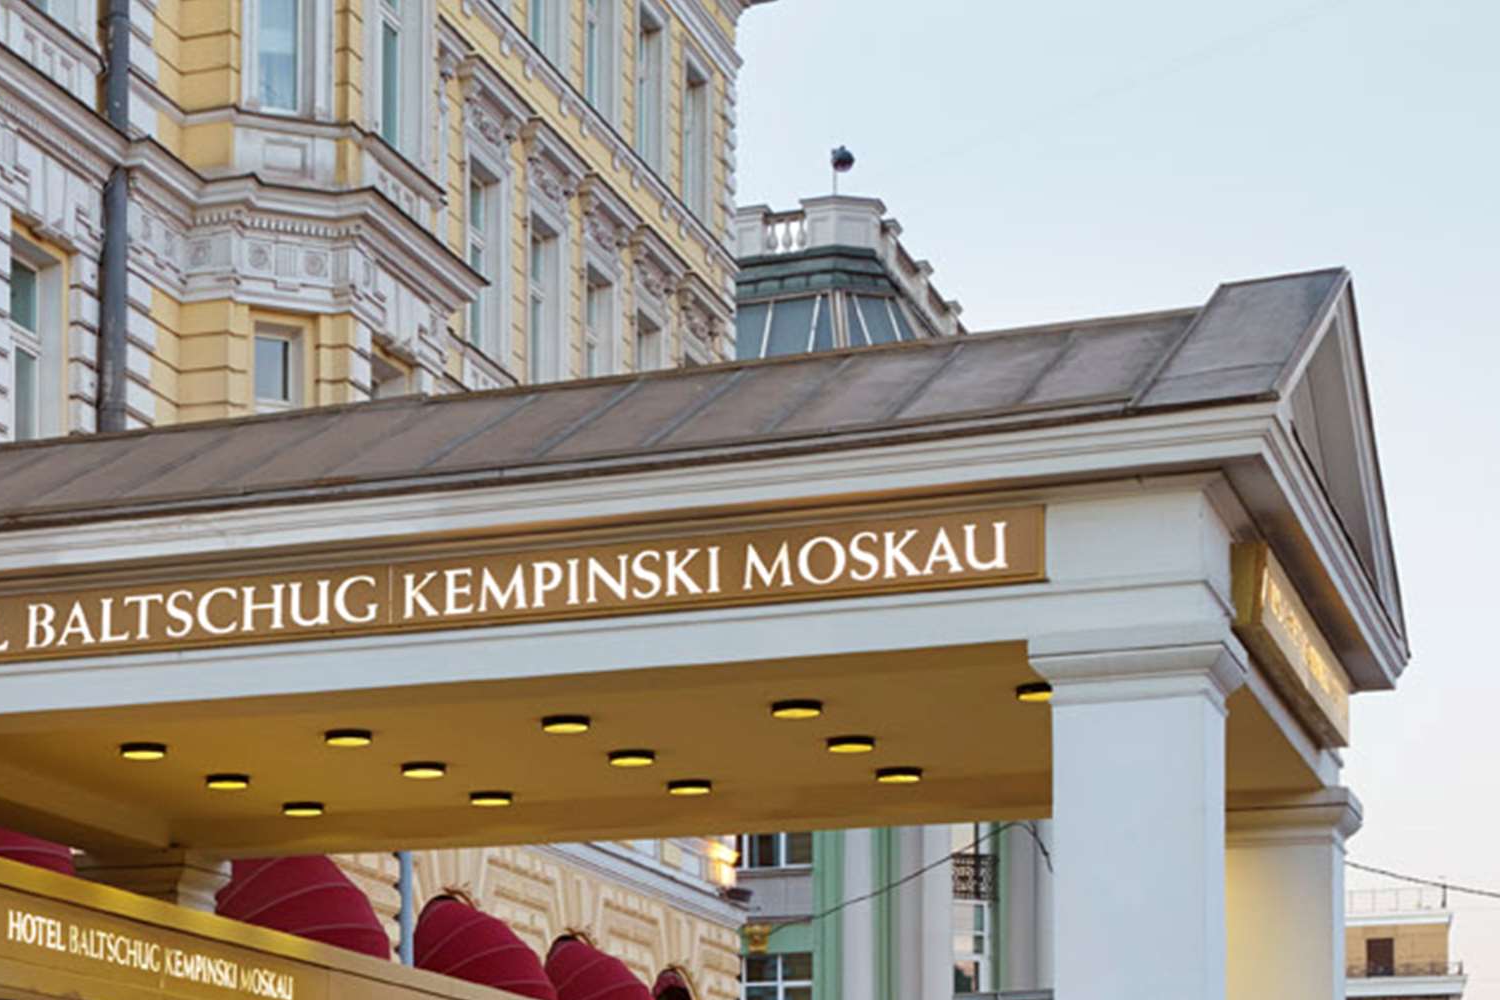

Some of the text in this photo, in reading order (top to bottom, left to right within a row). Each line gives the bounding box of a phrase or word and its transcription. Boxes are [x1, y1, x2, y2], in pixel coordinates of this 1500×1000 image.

[25, 575, 379, 650] BALTSCHUG
[402, 545, 721, 620] KEMPINSKI
[742, 520, 1009, 591] MOSKAU
[7, 909, 66, 952] HOTEL
[164, 948, 238, 990] KEMPINSKI
